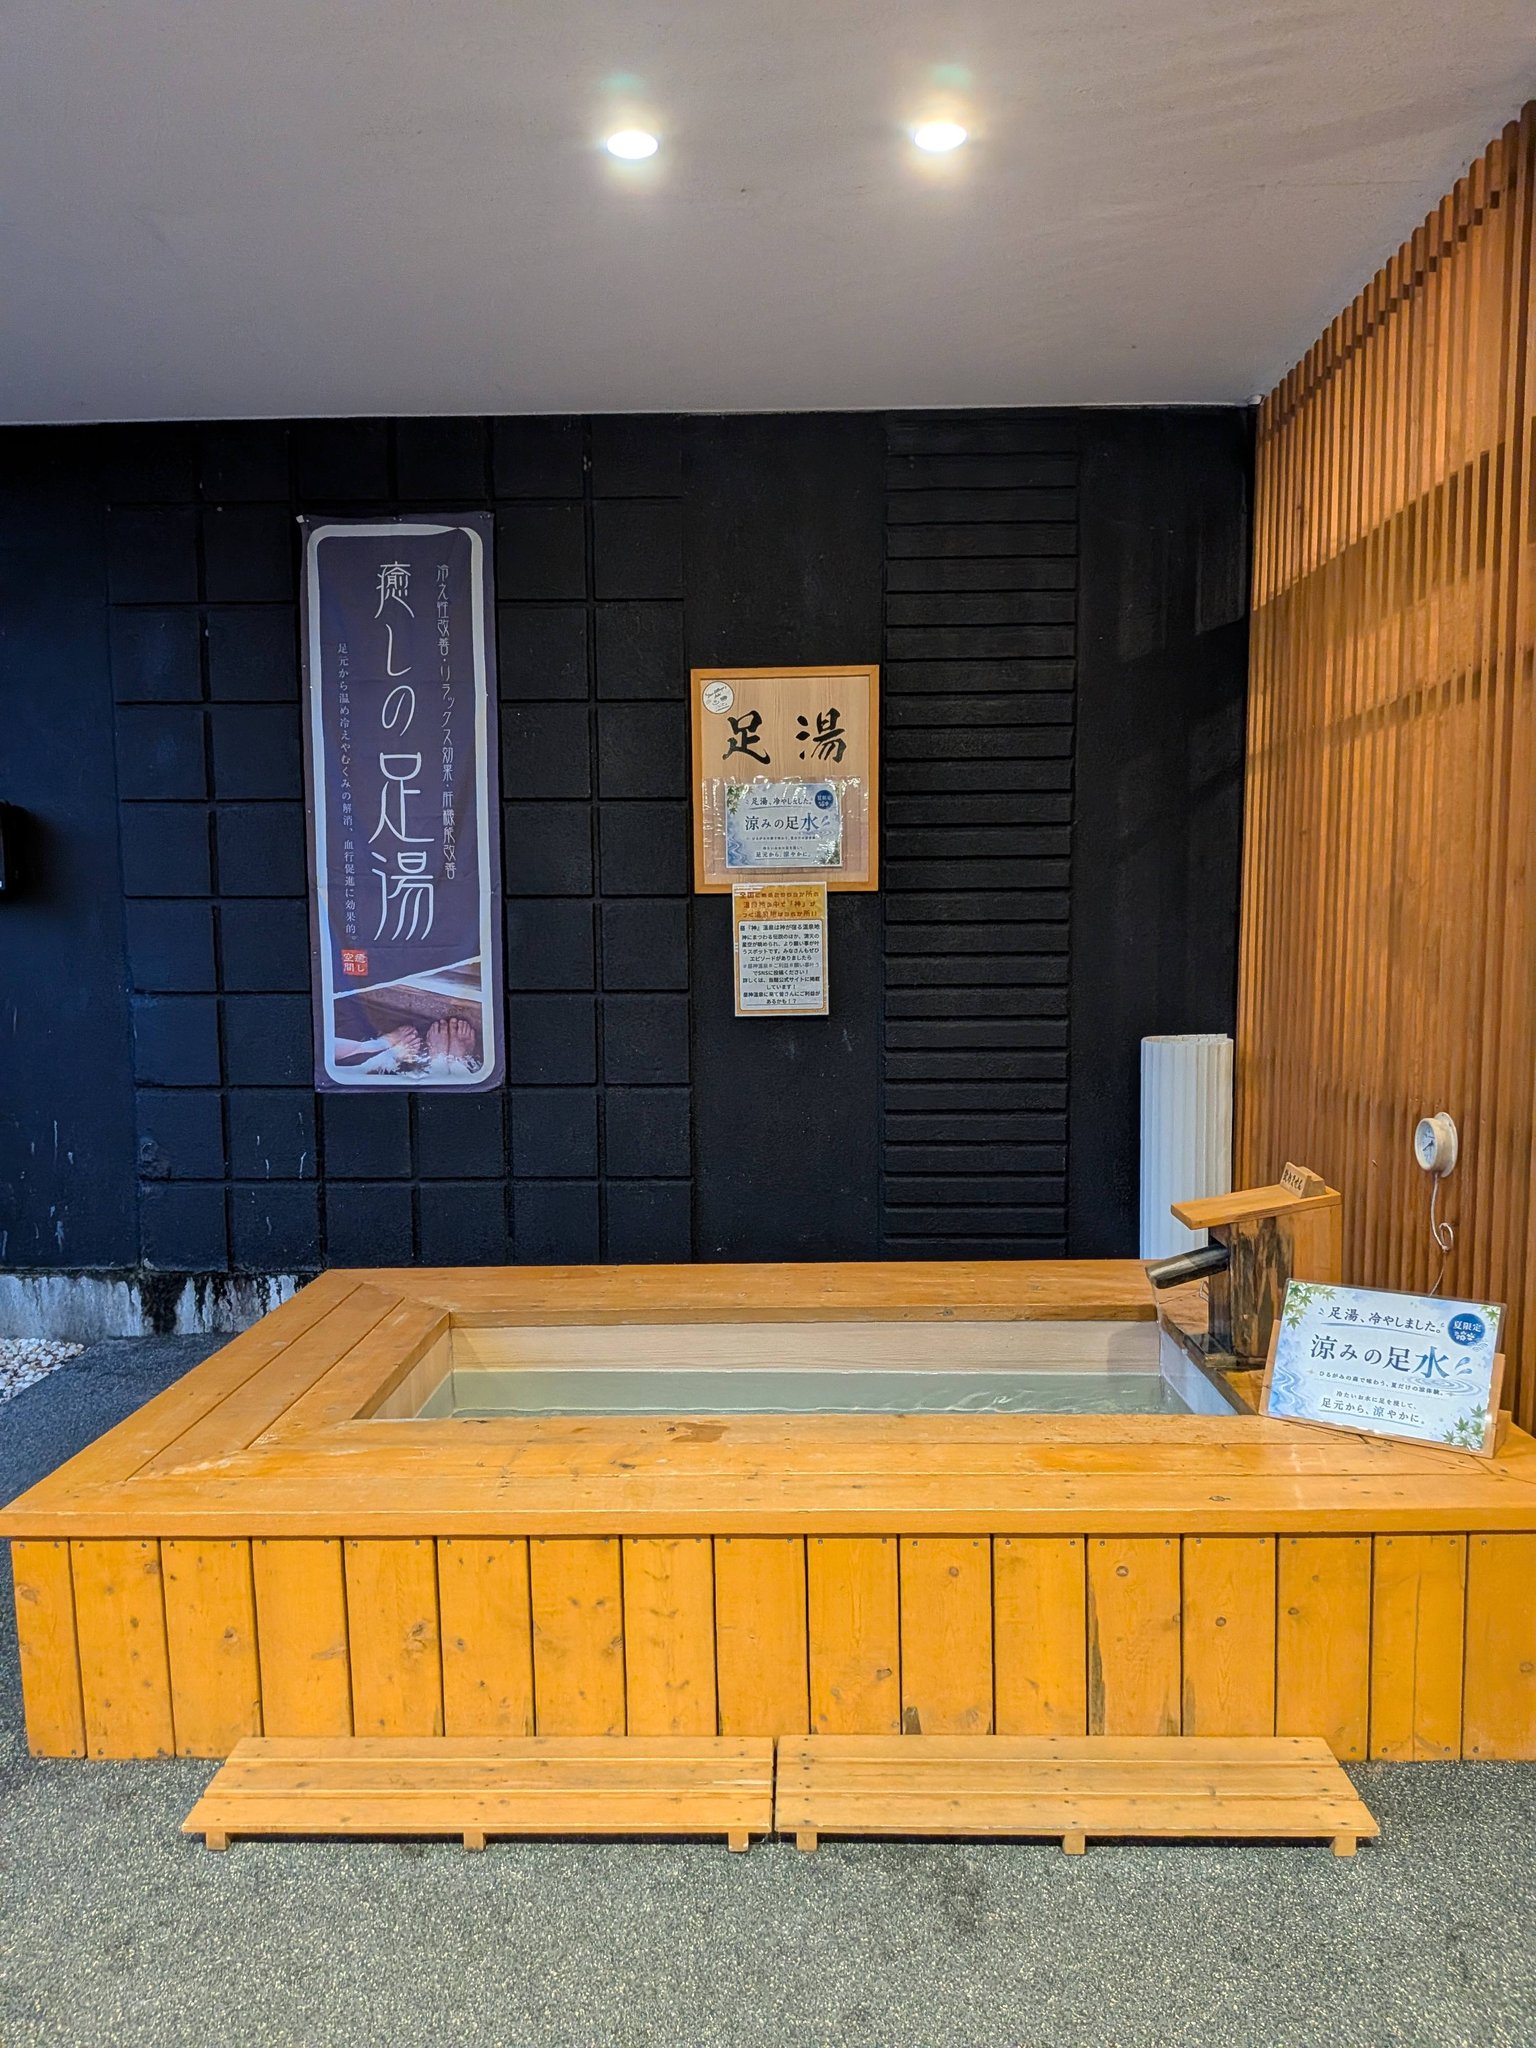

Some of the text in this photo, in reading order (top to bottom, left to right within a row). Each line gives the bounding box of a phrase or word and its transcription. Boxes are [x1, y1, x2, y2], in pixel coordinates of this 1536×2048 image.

[368, 561, 436, 941] 癒しの足湯
[722, 708, 847, 764] 足湯
[745, 812, 820, 831] 涼みの足水
[1328, 1306, 1441, 1334] 足湯、冷やしました。
[1311, 1333, 1450, 1379] 涼みの足水
[1321, 1397, 1425, 1425] 足元から、涼やかに。
